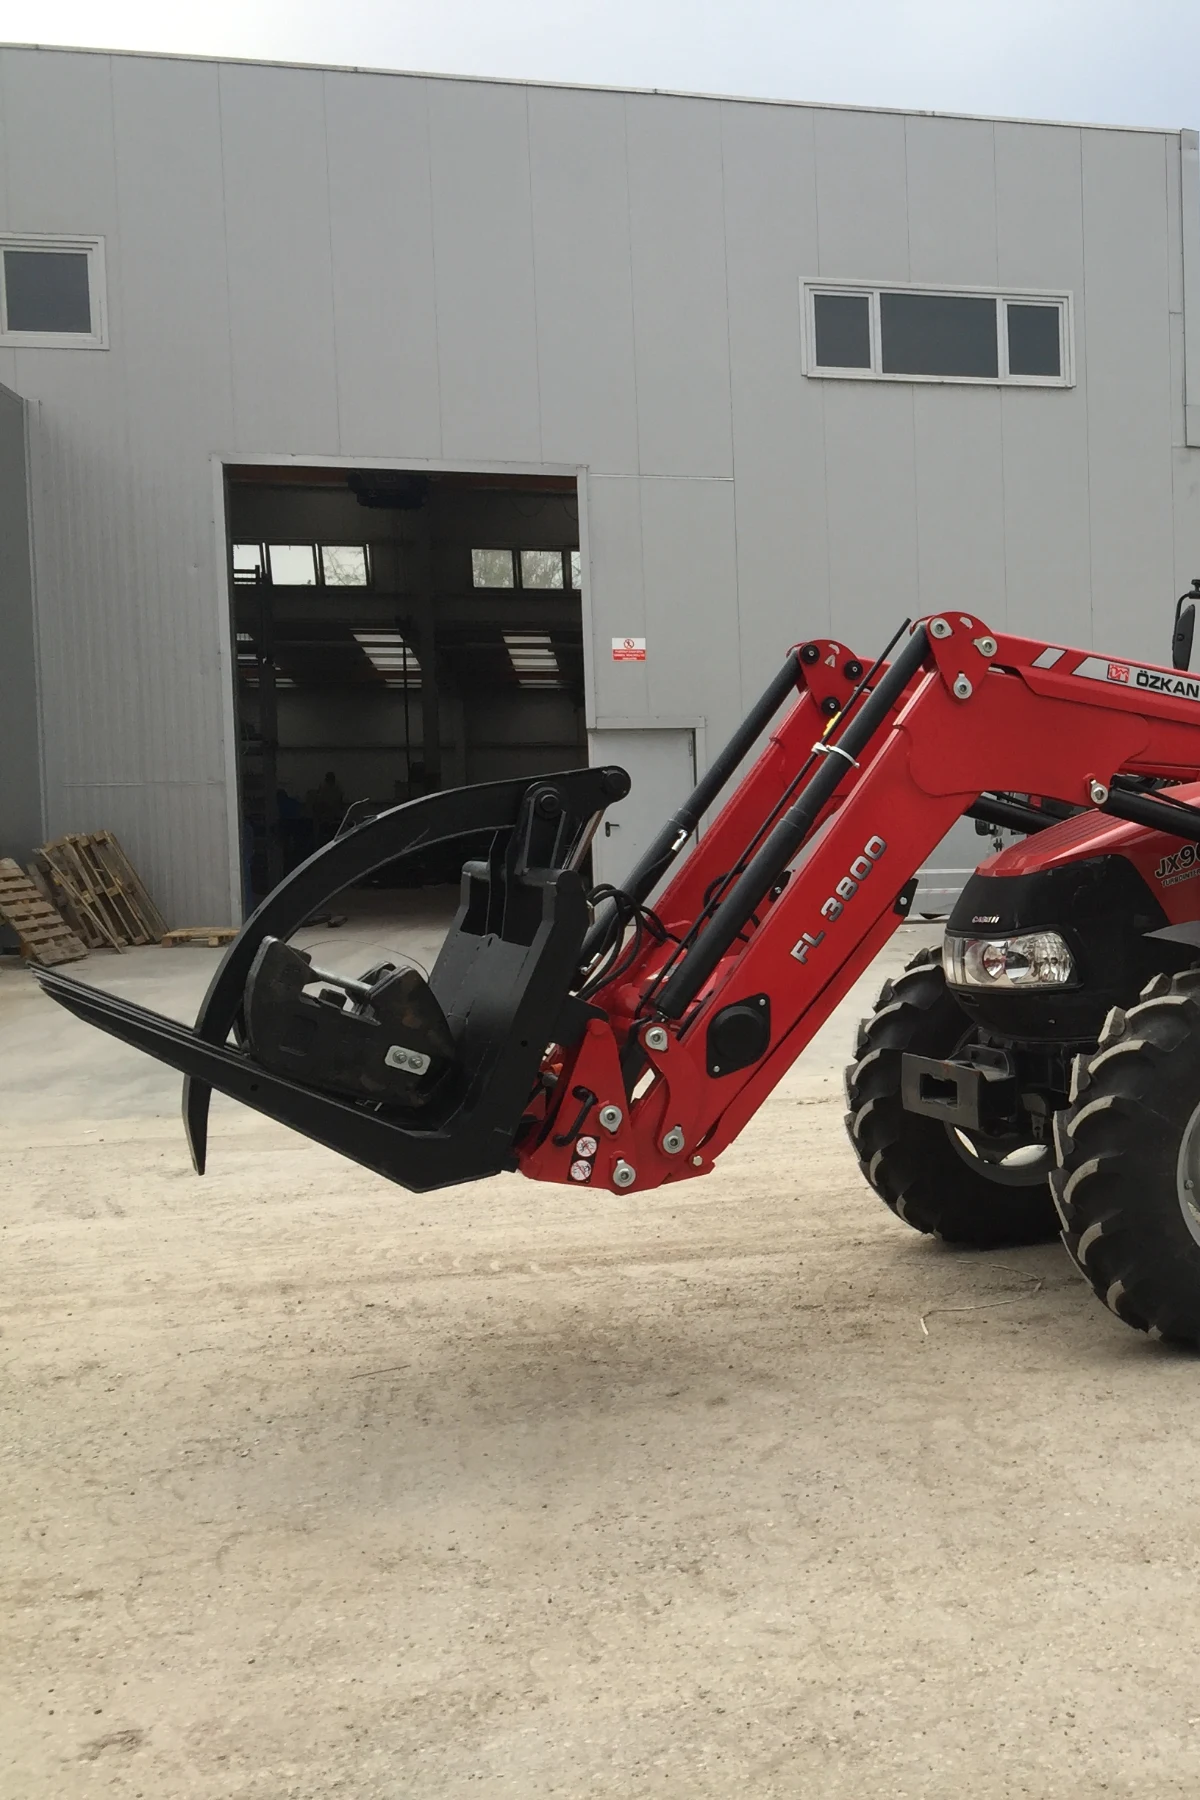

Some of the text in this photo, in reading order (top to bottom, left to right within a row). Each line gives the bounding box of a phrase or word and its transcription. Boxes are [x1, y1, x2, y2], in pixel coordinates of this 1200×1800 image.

[1136, 670, 1200, 698] ÖZKAN
[790, 835, 887, 965] FL 3800
